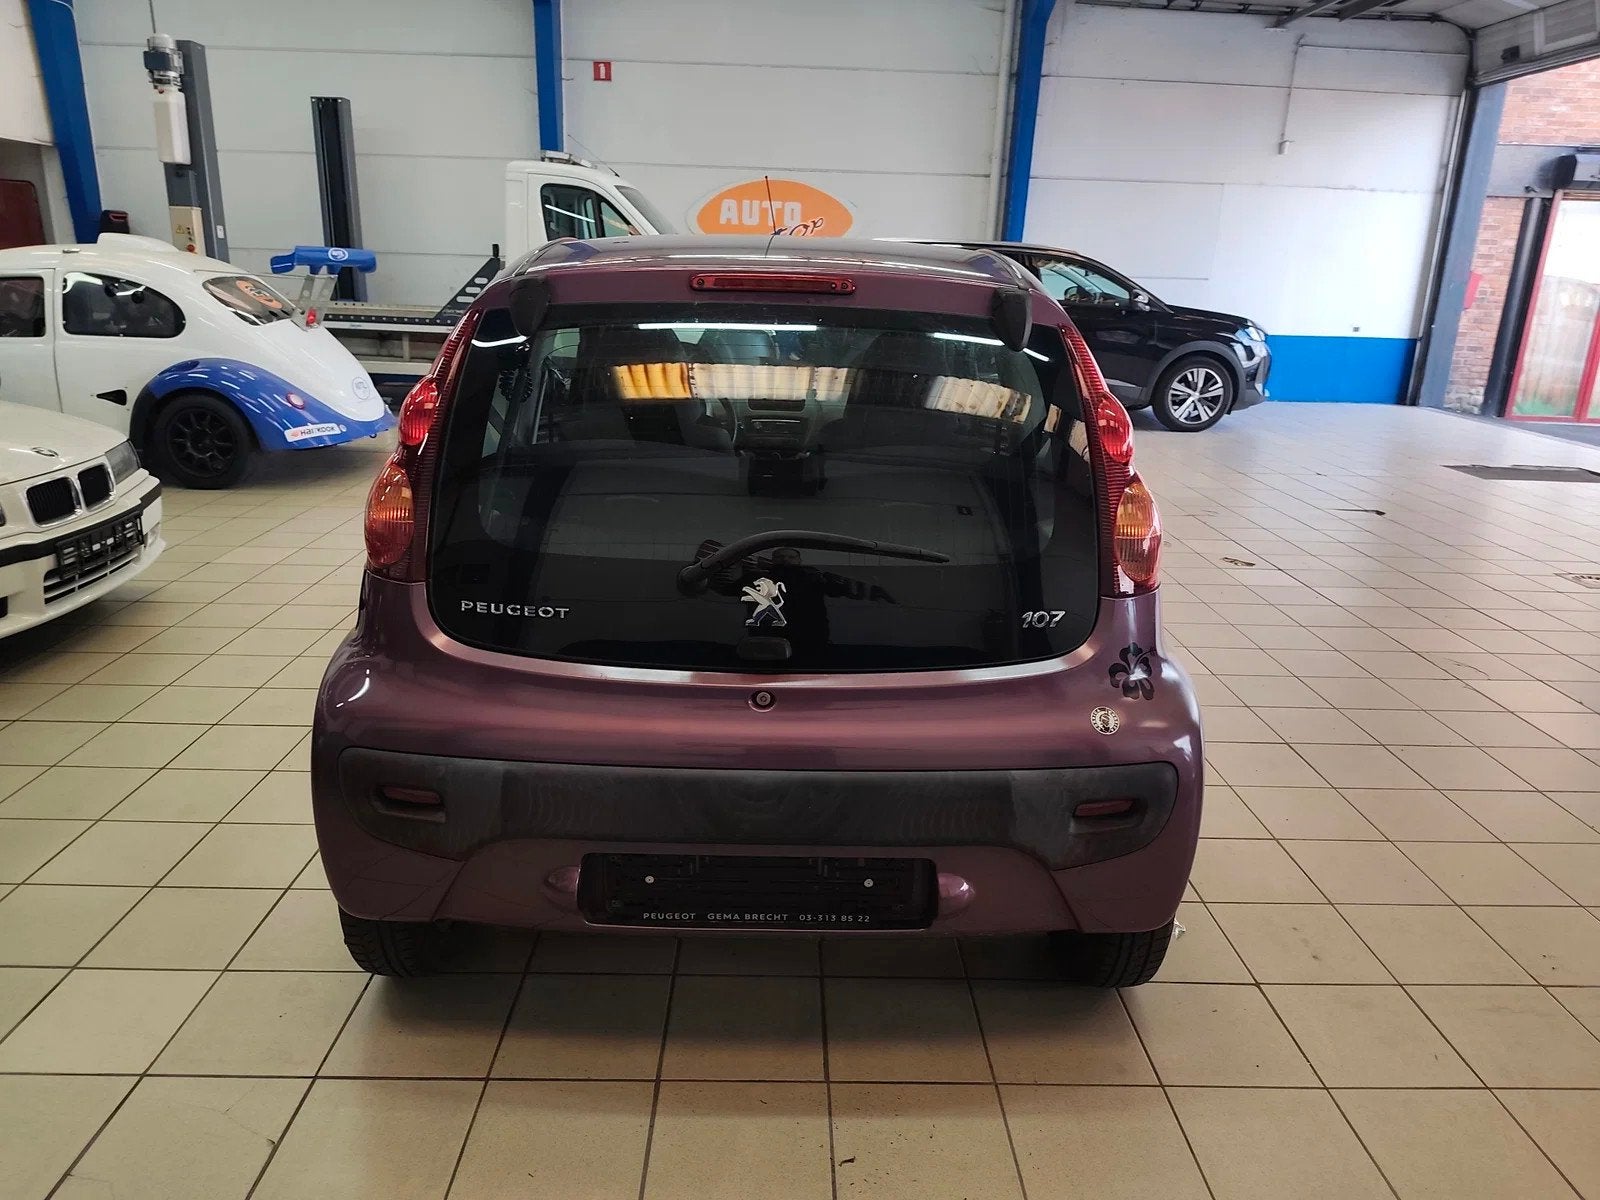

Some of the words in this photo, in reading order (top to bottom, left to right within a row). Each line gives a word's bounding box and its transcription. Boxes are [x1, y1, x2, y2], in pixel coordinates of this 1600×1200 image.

[719, 199, 803, 227] AUTO
[460, 600, 570, 619] PEUGEOT
[1021, 610, 1066, 628] 107
[643, 912, 697, 920] PEUGEOT
[707, 912, 741, 921] GEMA
[744, 913, 789, 921] BRECHT
[798, 913, 837, 922] 03-313
[840, 914, 854, 923] 85
[857, 914, 871, 923] 22
